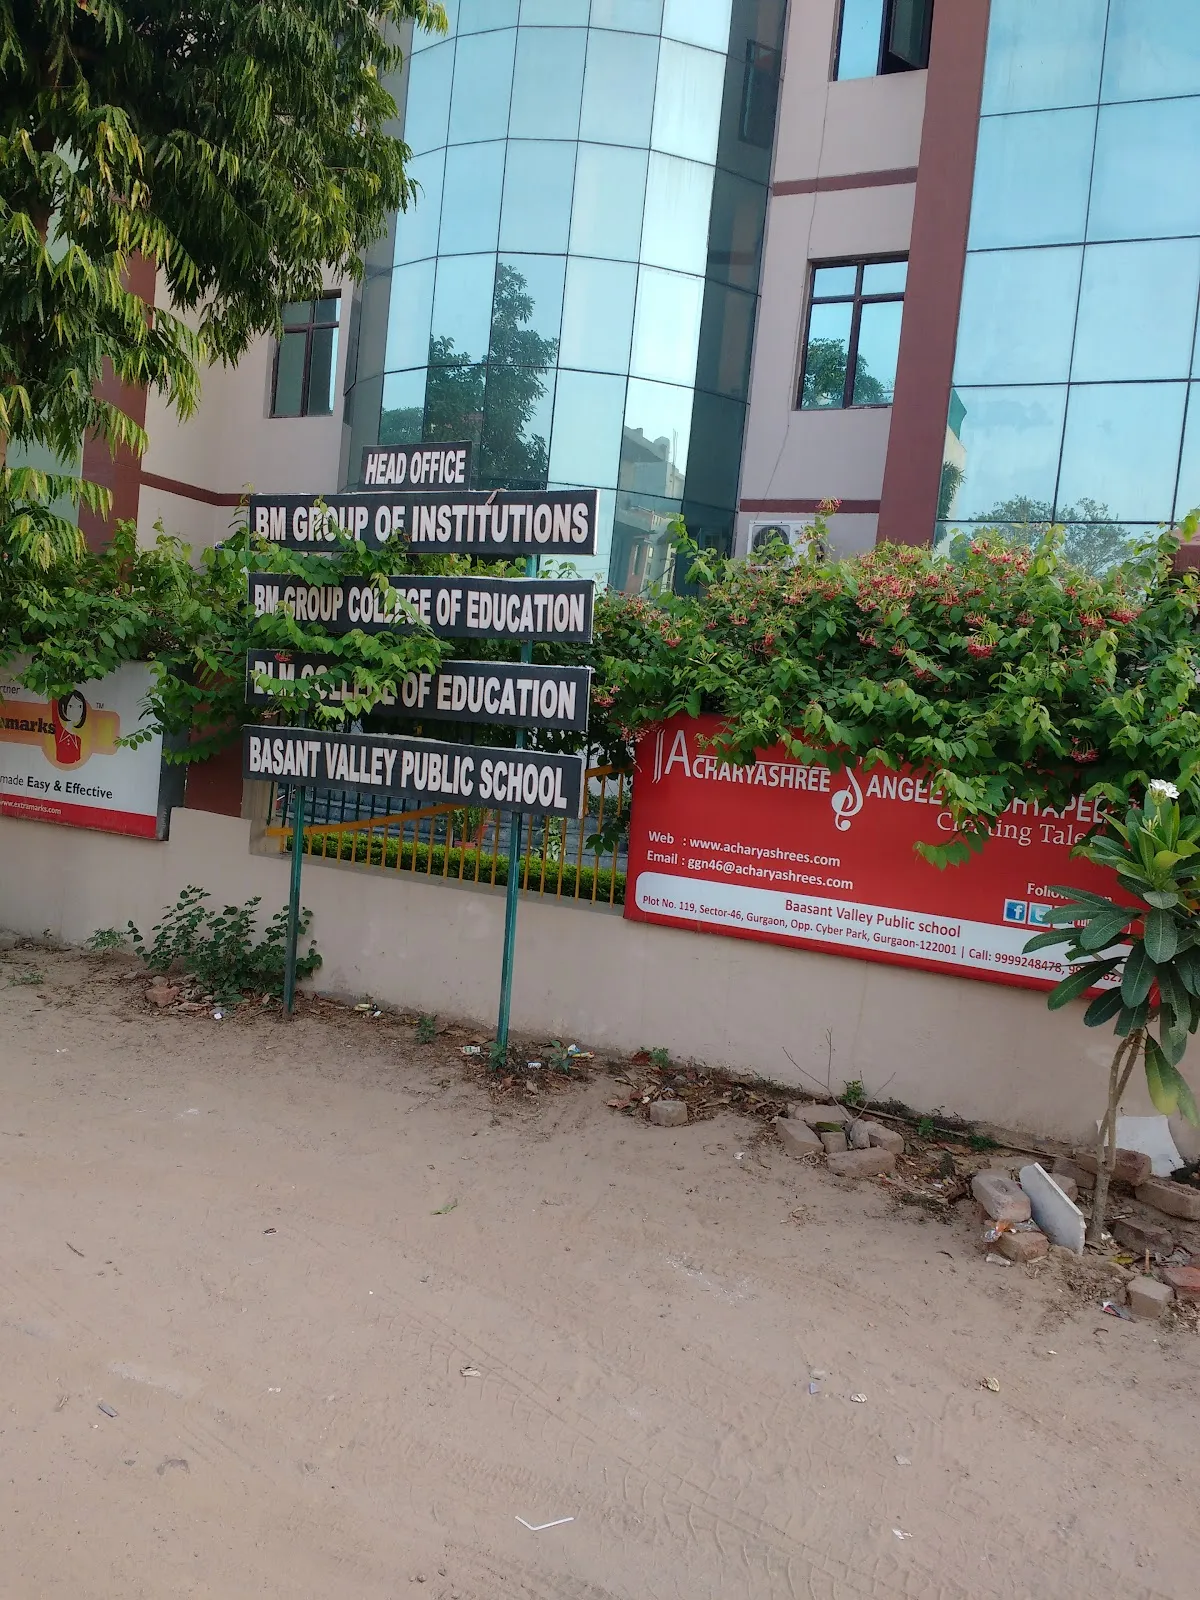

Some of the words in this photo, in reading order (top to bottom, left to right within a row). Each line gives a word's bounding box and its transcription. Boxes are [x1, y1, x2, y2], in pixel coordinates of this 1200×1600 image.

[365, 453, 407, 484] HEAD
[410, 450, 466, 484] OFFICE
[255, 507, 286, 541] BM
[292, 506, 369, 541] GROUP
[375, 505, 405, 541] OF
[411, 502, 588, 543] INSTITUTIONS
[254, 585, 280, 617] BM
[284, 586, 344, 622] GROUP
[436, 588, 463, 626] OF
[466, 590, 585, 633] EDUCATION
[402, 671, 432, 708] OF
[436, 674, 577, 720] EDUCATION
[27, 775, 51, 793] Easy
[53, 780, 62, 792] &
[65, 781, 113, 799] Effective
[249, 736, 321, 778] BASANT
[325, 742, 397, 786] VALLEY
[401, 753, 474, 798] PUBLIC
[479, 759, 567, 809] SCHOOL
[648, 831, 674, 845] Web
[689, 838, 841, 868] www.acharyashrees.com
[647, 850, 678, 866] Email
[687, 858, 854, 891] ggn46@acharyashrees.com
[643, 895, 660, 907] Plot
[661, 898, 677, 909] No.
[679, 901, 697, 914] 119,
[699, 905, 744, 921] Sector-46,
[746, 912, 788, 929] Gurgaon,
[790, 919, 813, 932] Opp.
[815, 923, 844, 937] Cyber
[846, 927, 870, 943] Park,
[873, 932, 957, 955] Gurgaon-122001
[968, 948, 992, 961] Call:
[994, 952, 1065, 976] 9999248478,
[785, 899, 833, 917] Baasant
[836, 906, 873, 926] Valley
[876, 913, 915, 931] Public
[918, 921, 961, 938] school
